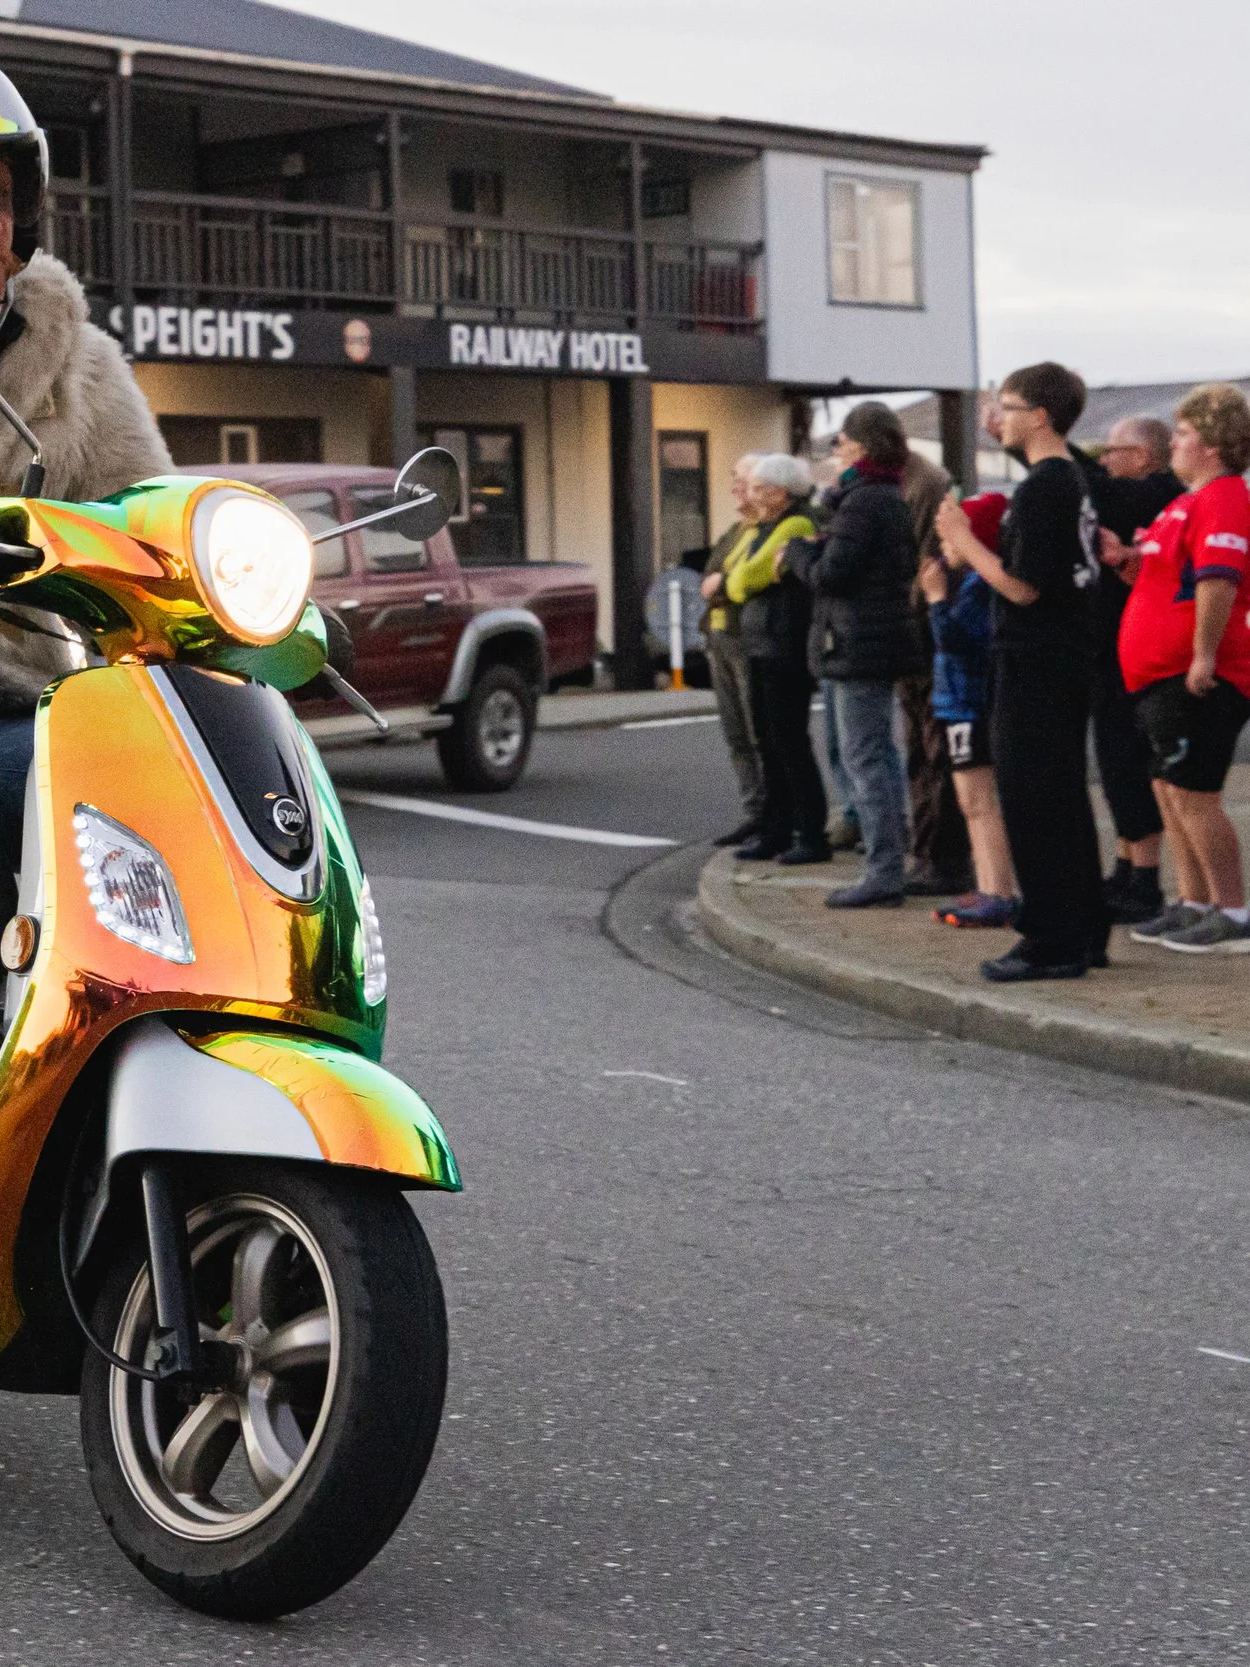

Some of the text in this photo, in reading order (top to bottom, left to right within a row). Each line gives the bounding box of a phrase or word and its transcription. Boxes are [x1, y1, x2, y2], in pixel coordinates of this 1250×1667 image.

[450, 323, 649, 373] RAILWAY HOTEL
[277, 809, 302, 824] SYM
